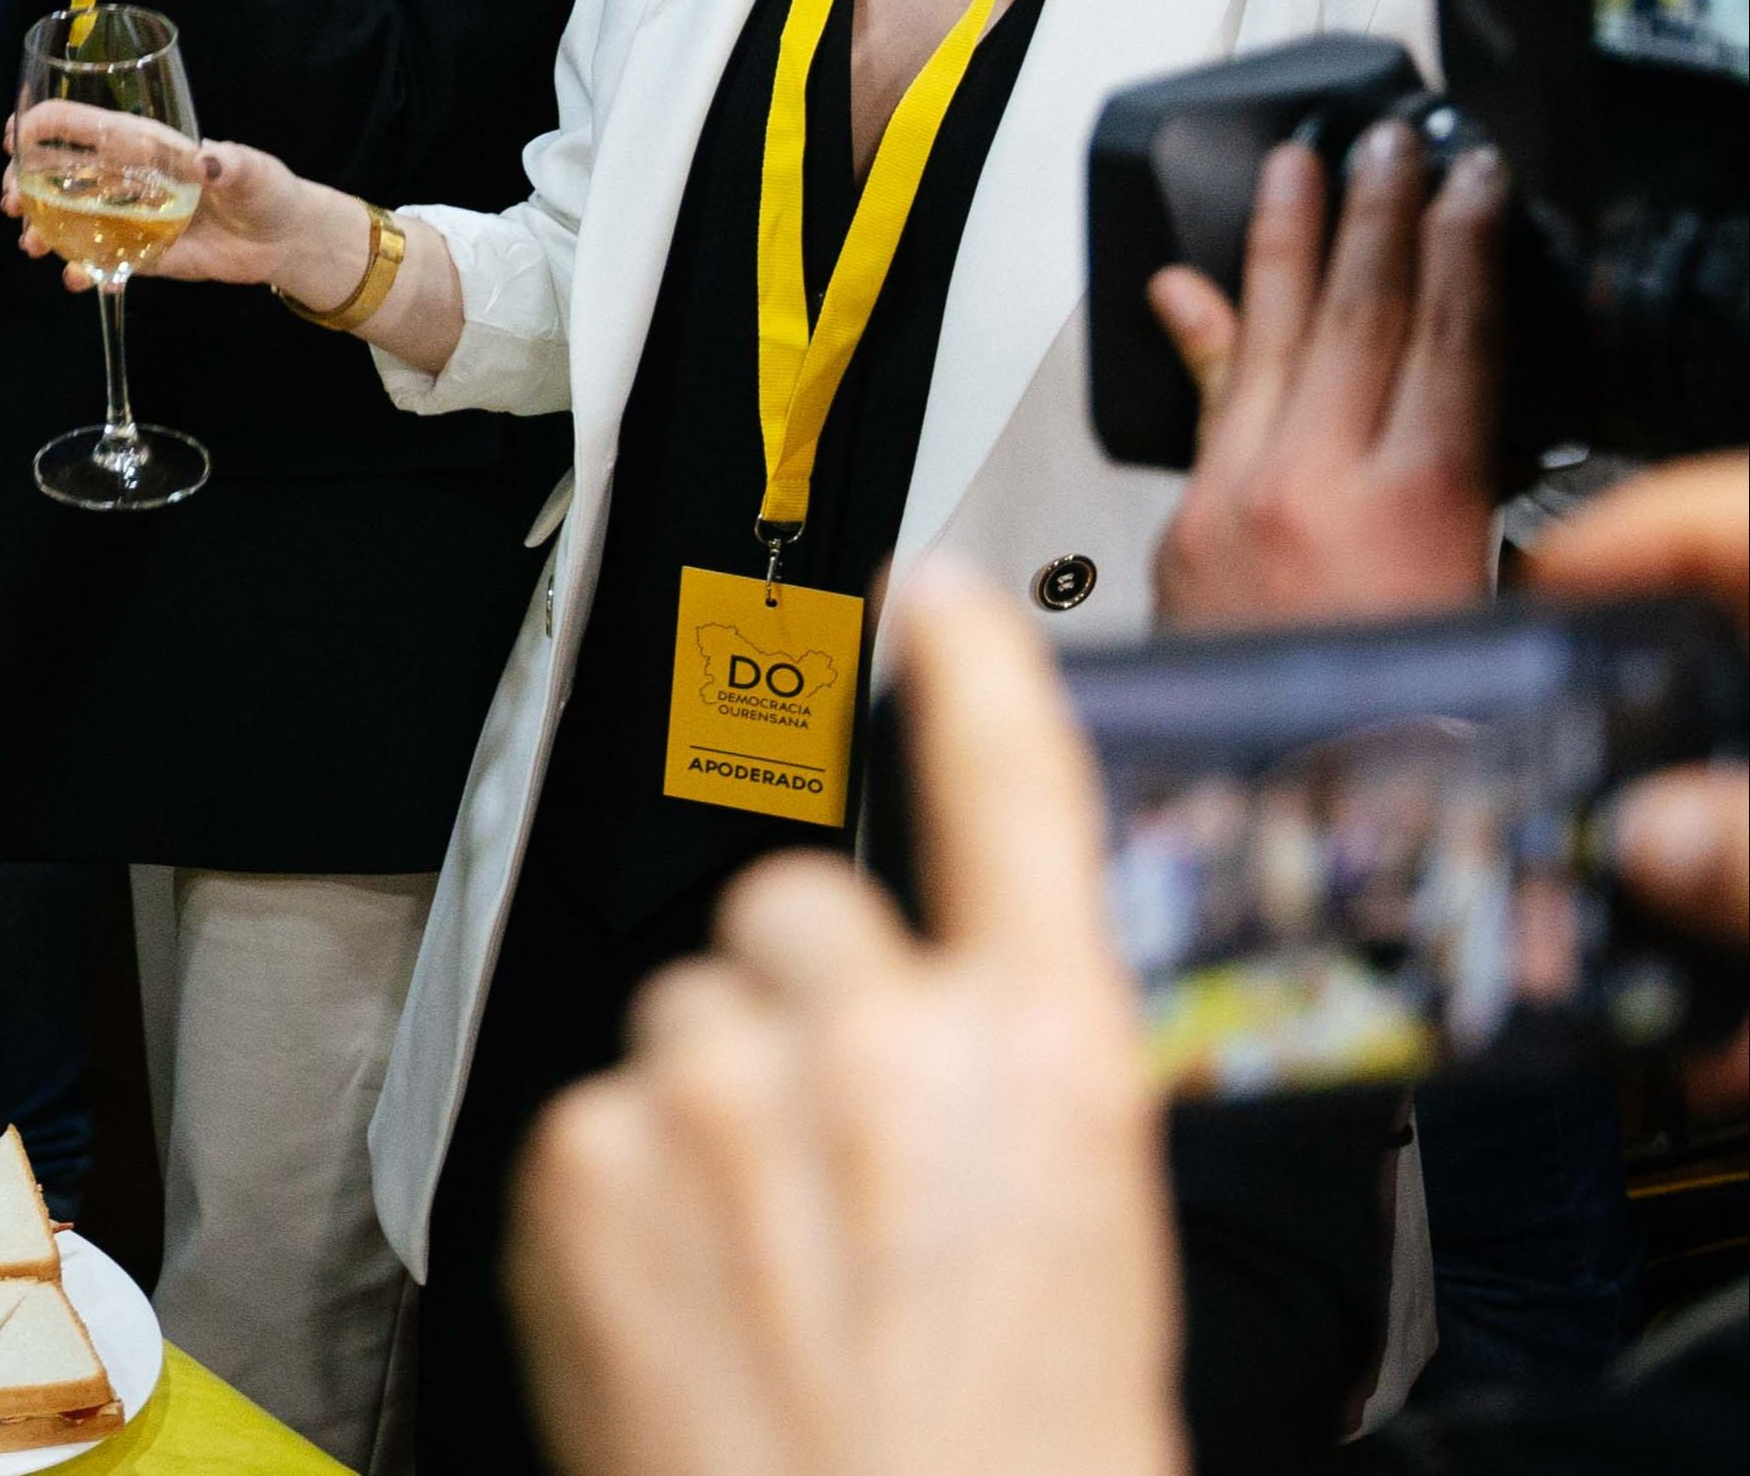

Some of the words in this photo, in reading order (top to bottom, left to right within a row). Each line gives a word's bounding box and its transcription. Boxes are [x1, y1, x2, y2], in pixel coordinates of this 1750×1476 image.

[728, 654, 804, 698] DO
[717, 690, 812, 717] DEMOCRACIA
[718, 704, 809, 730] OURENSANA
[688, 757, 823, 794] APODERADO
